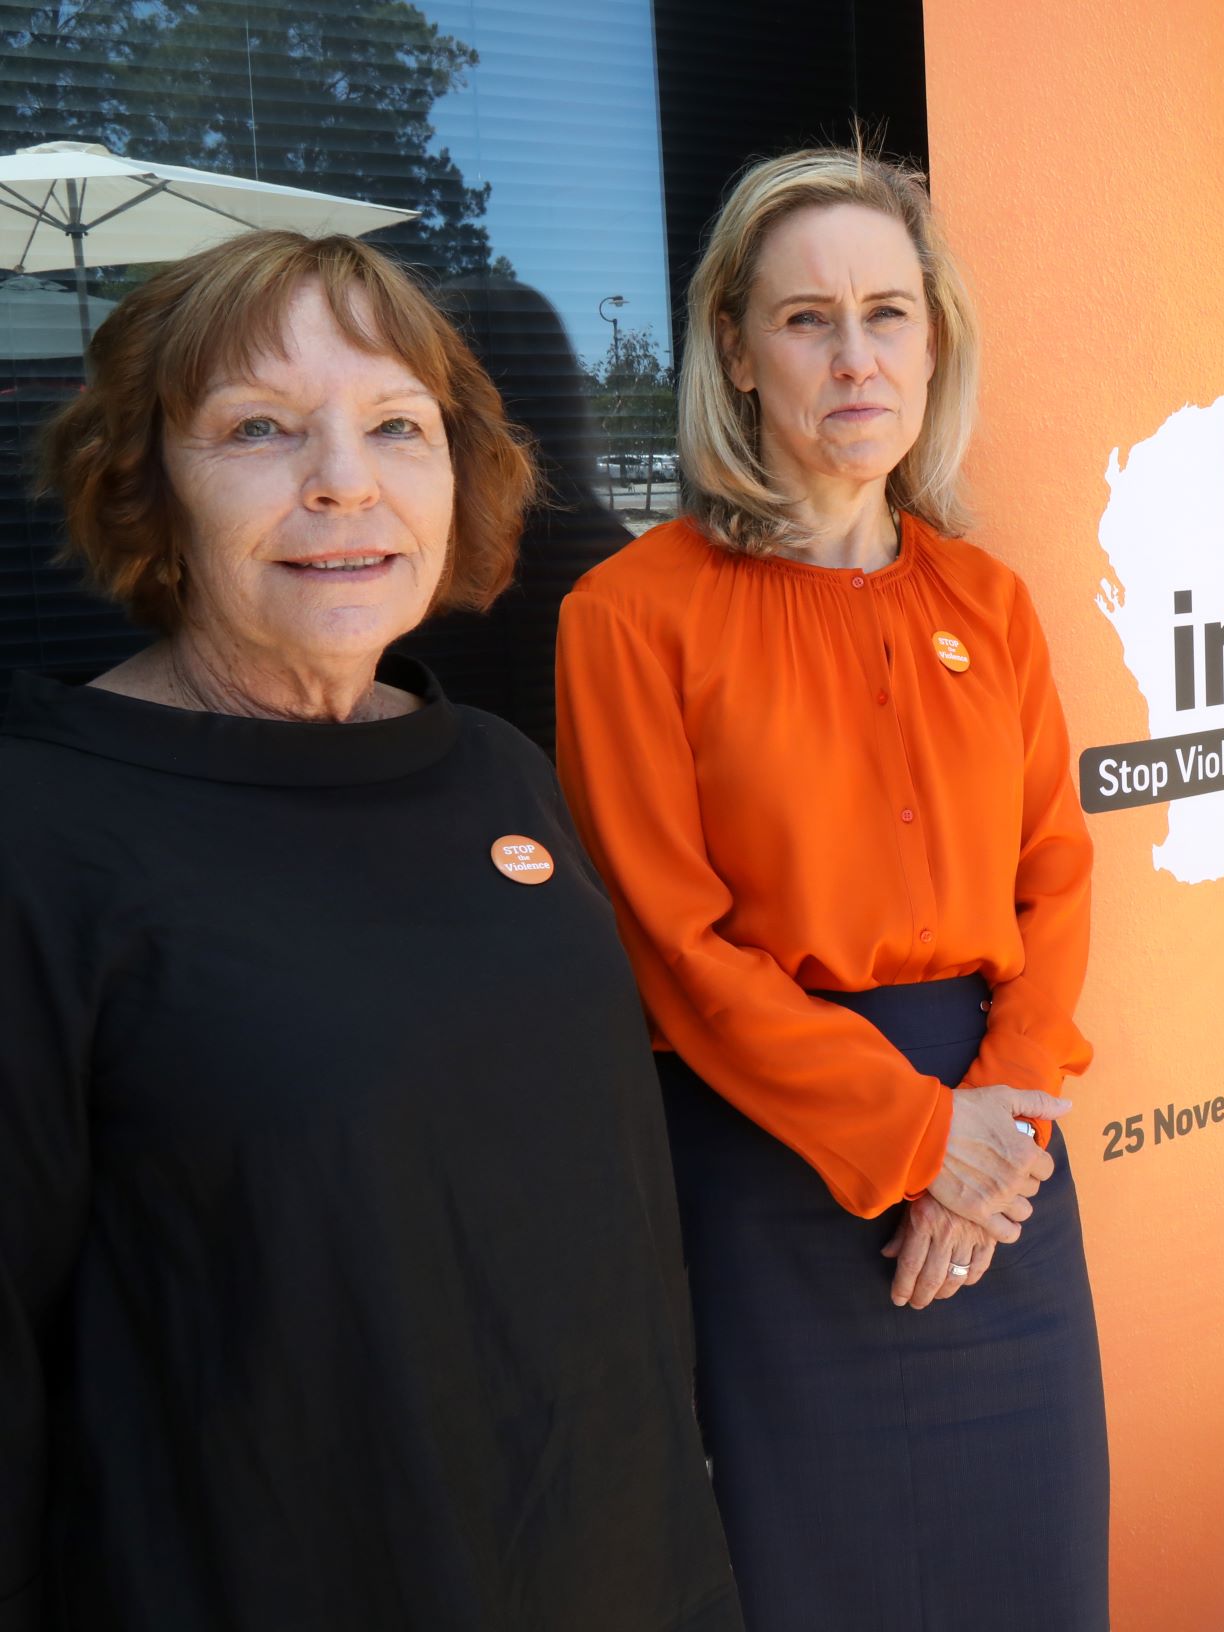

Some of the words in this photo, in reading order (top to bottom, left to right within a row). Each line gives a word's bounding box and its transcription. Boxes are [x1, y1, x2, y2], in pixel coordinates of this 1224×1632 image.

[1098, 758, 1168, 797] Stop
[503, 844, 535, 855] STOP
[504, 861, 551, 872] Violence
[1101, 1113, 1145, 1162] 25
